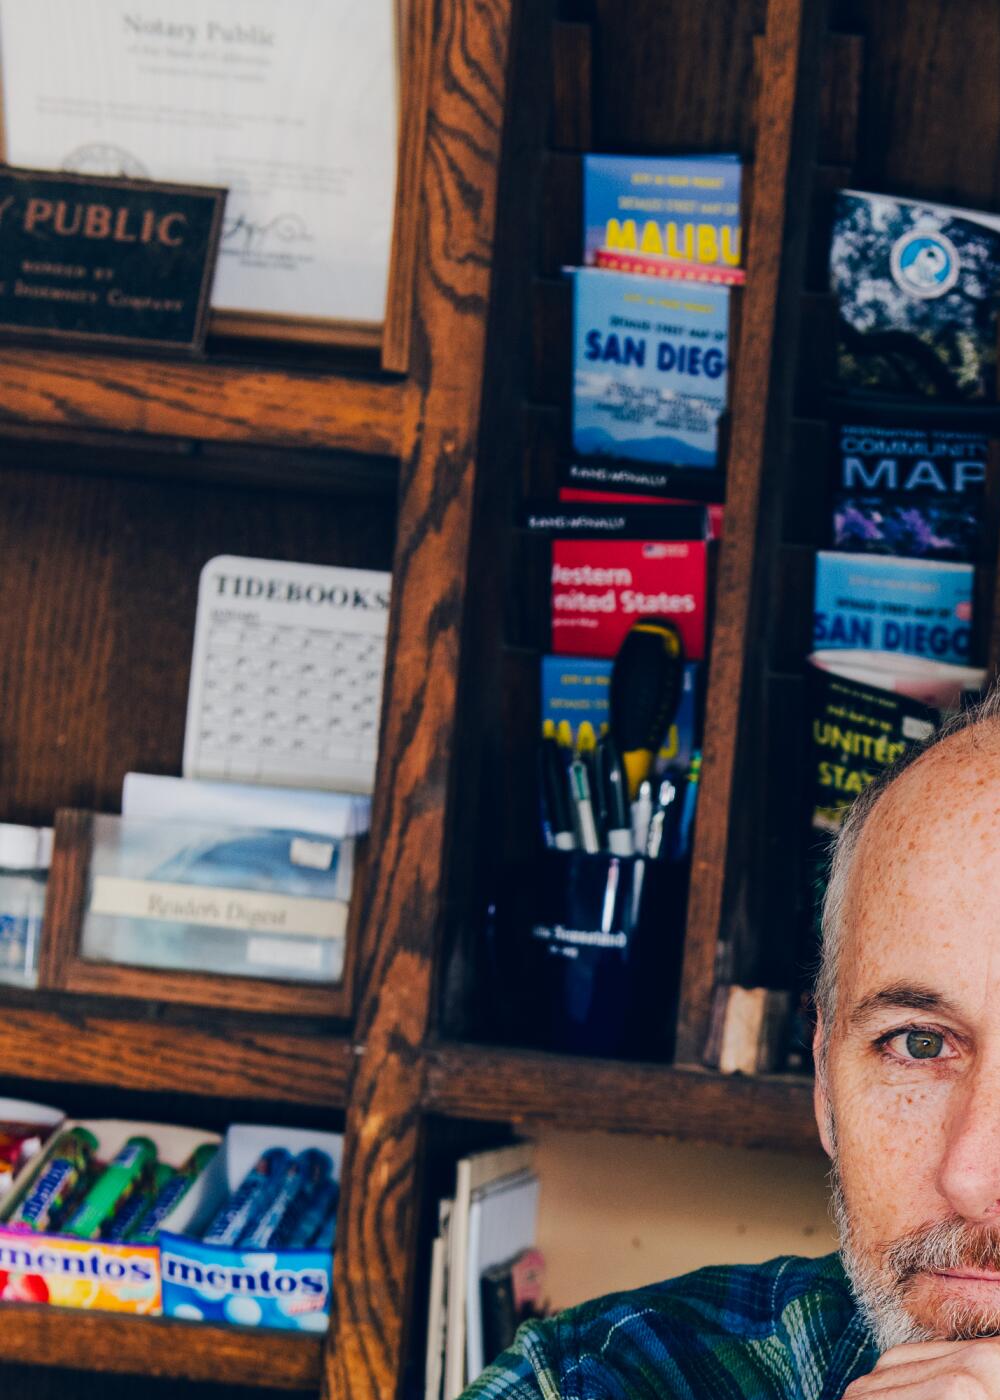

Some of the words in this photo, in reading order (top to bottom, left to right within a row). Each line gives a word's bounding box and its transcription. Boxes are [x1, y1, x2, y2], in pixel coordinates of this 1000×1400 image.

[24, 199, 188, 247] PUBLIC
[606, 218, 743, 266] MALIBU
[586, 329, 645, 368] SAN
[656, 341, 730, 380] DIEG
[843, 457, 986, 493] MAP
[212, 573, 390, 610] TIDEBOOKS
[553, 589, 616, 613] nited
[620, 590, 696, 614] States
[814, 610, 874, 646] SAN
[884, 619, 973, 657] DIEGO
[0, 1246, 153, 1282] mentos
[165, 1256, 326, 1297] mentos
